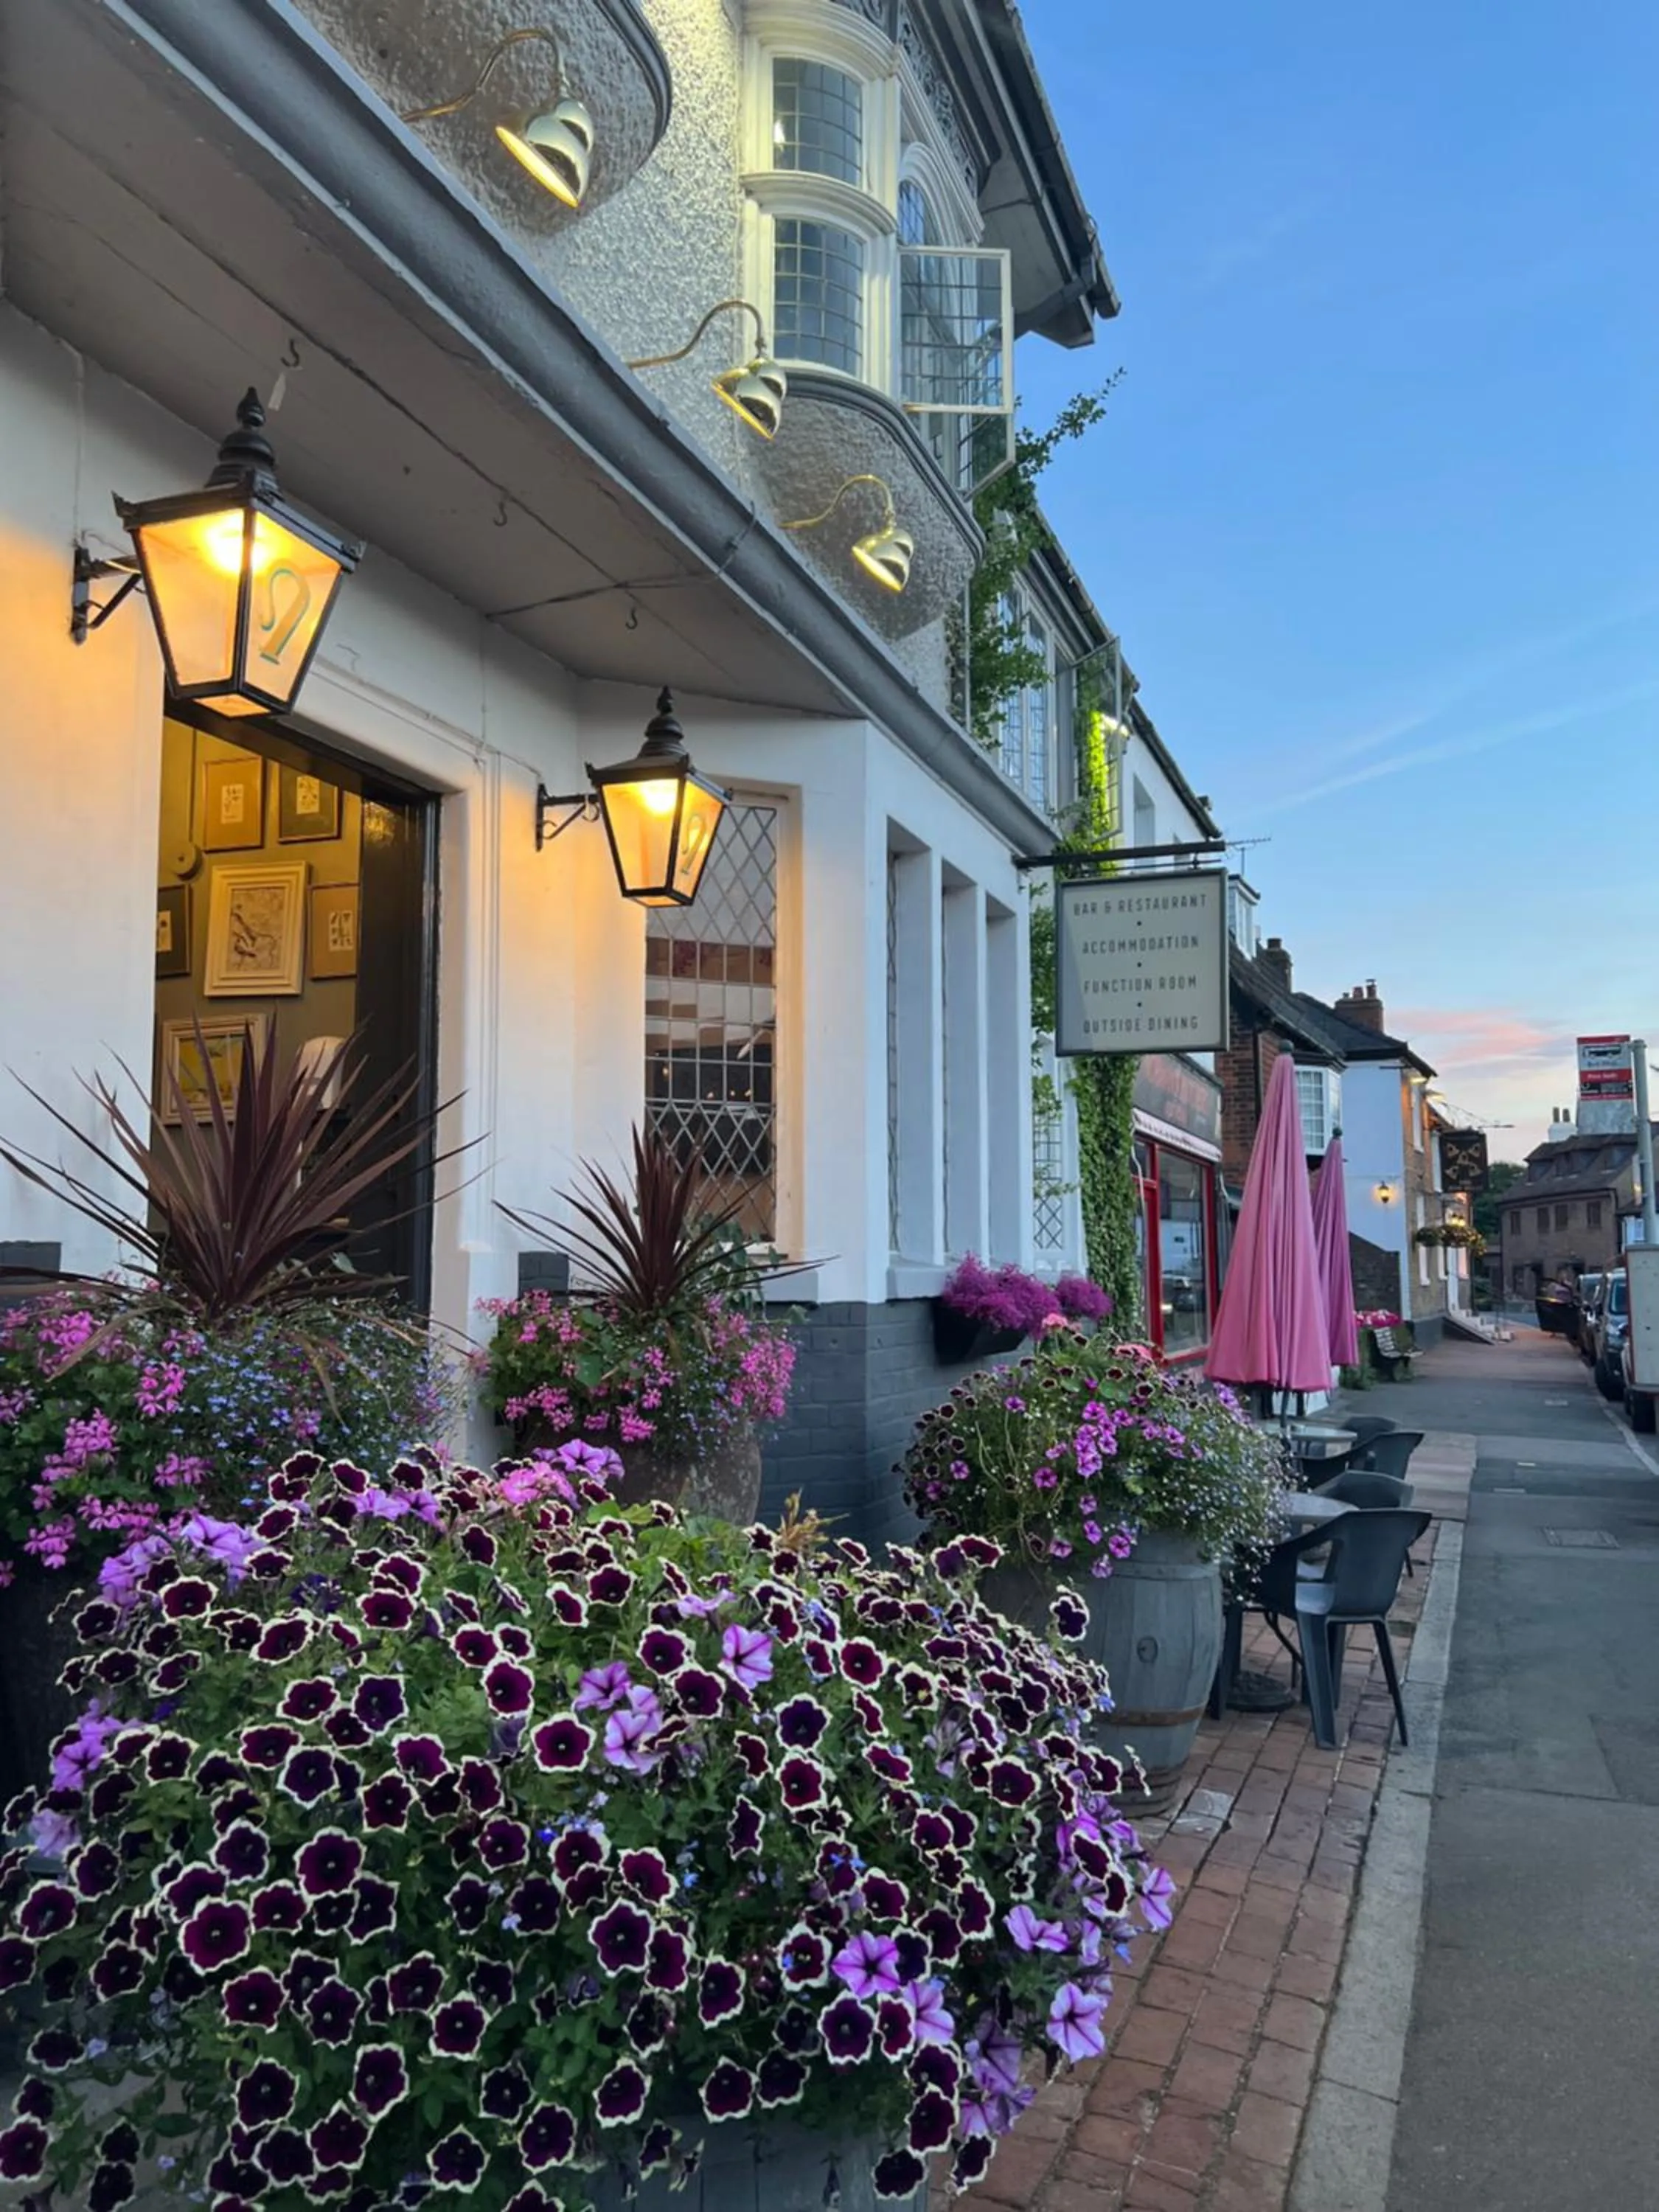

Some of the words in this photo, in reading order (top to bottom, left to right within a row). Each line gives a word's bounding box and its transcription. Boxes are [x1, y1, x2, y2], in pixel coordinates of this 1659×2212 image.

[1074, 902, 1098, 917] BAR
[1105, 900, 1112, 914] &
[1118, 894, 1208, 914] RESTAURANT
[1082, 935, 1200, 955] ACCOMMODATION
[1084, 978, 1152, 994] FUNCTION
[1158, 974, 1197, 990] ROOM
[1082, 1018, 1142, 1034] OUTSIDE
[1147, 1015, 1199, 1032] DINING
